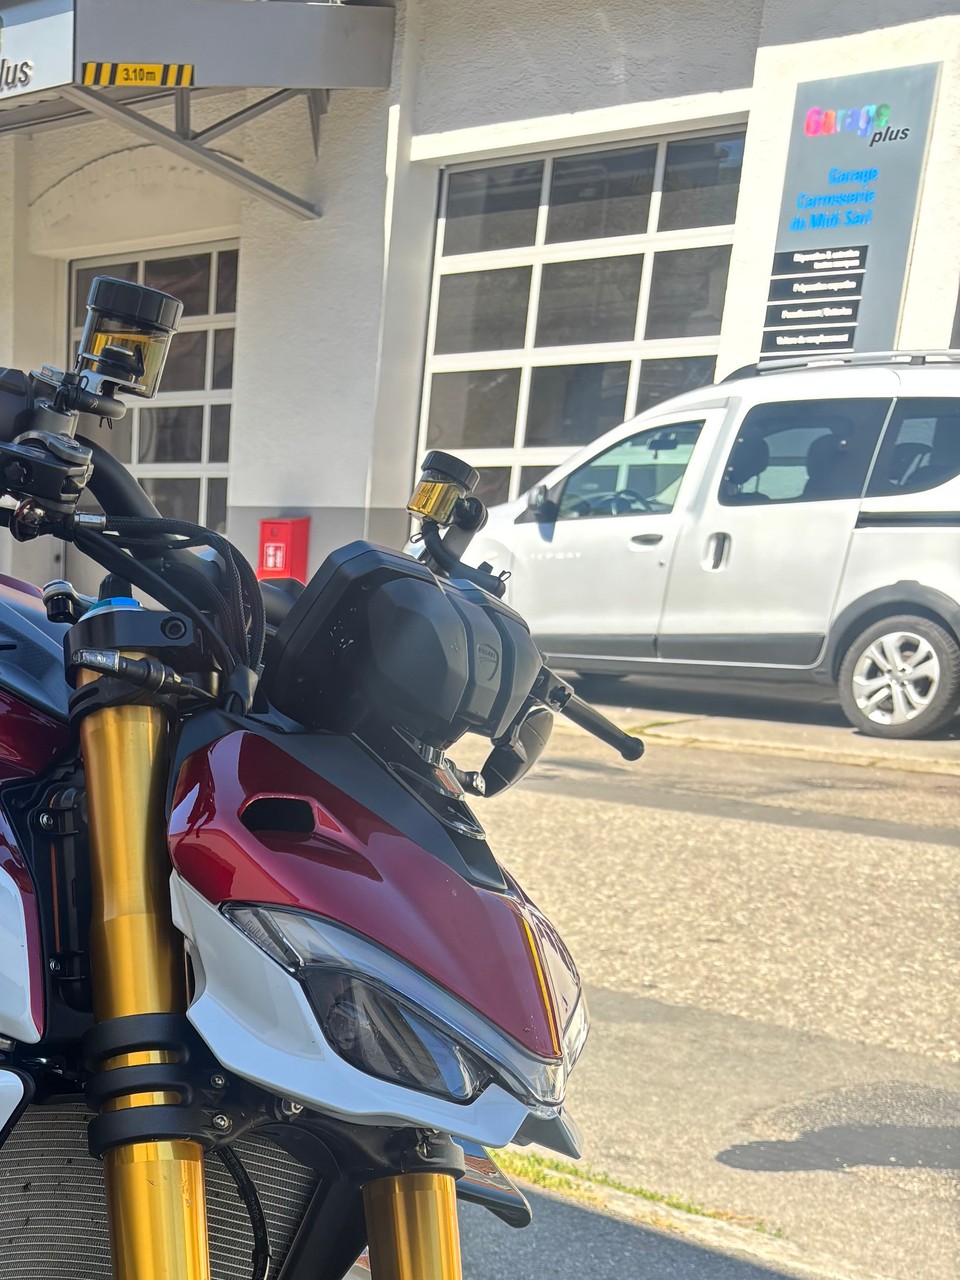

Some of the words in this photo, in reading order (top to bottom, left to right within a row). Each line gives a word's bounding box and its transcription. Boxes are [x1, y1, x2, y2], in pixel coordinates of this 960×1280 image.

[804, 103, 890, 138] Garage
[869, 126, 910, 147] plus
[828, 167, 880, 187] Garage
[809, 211, 840, 229] Midi
